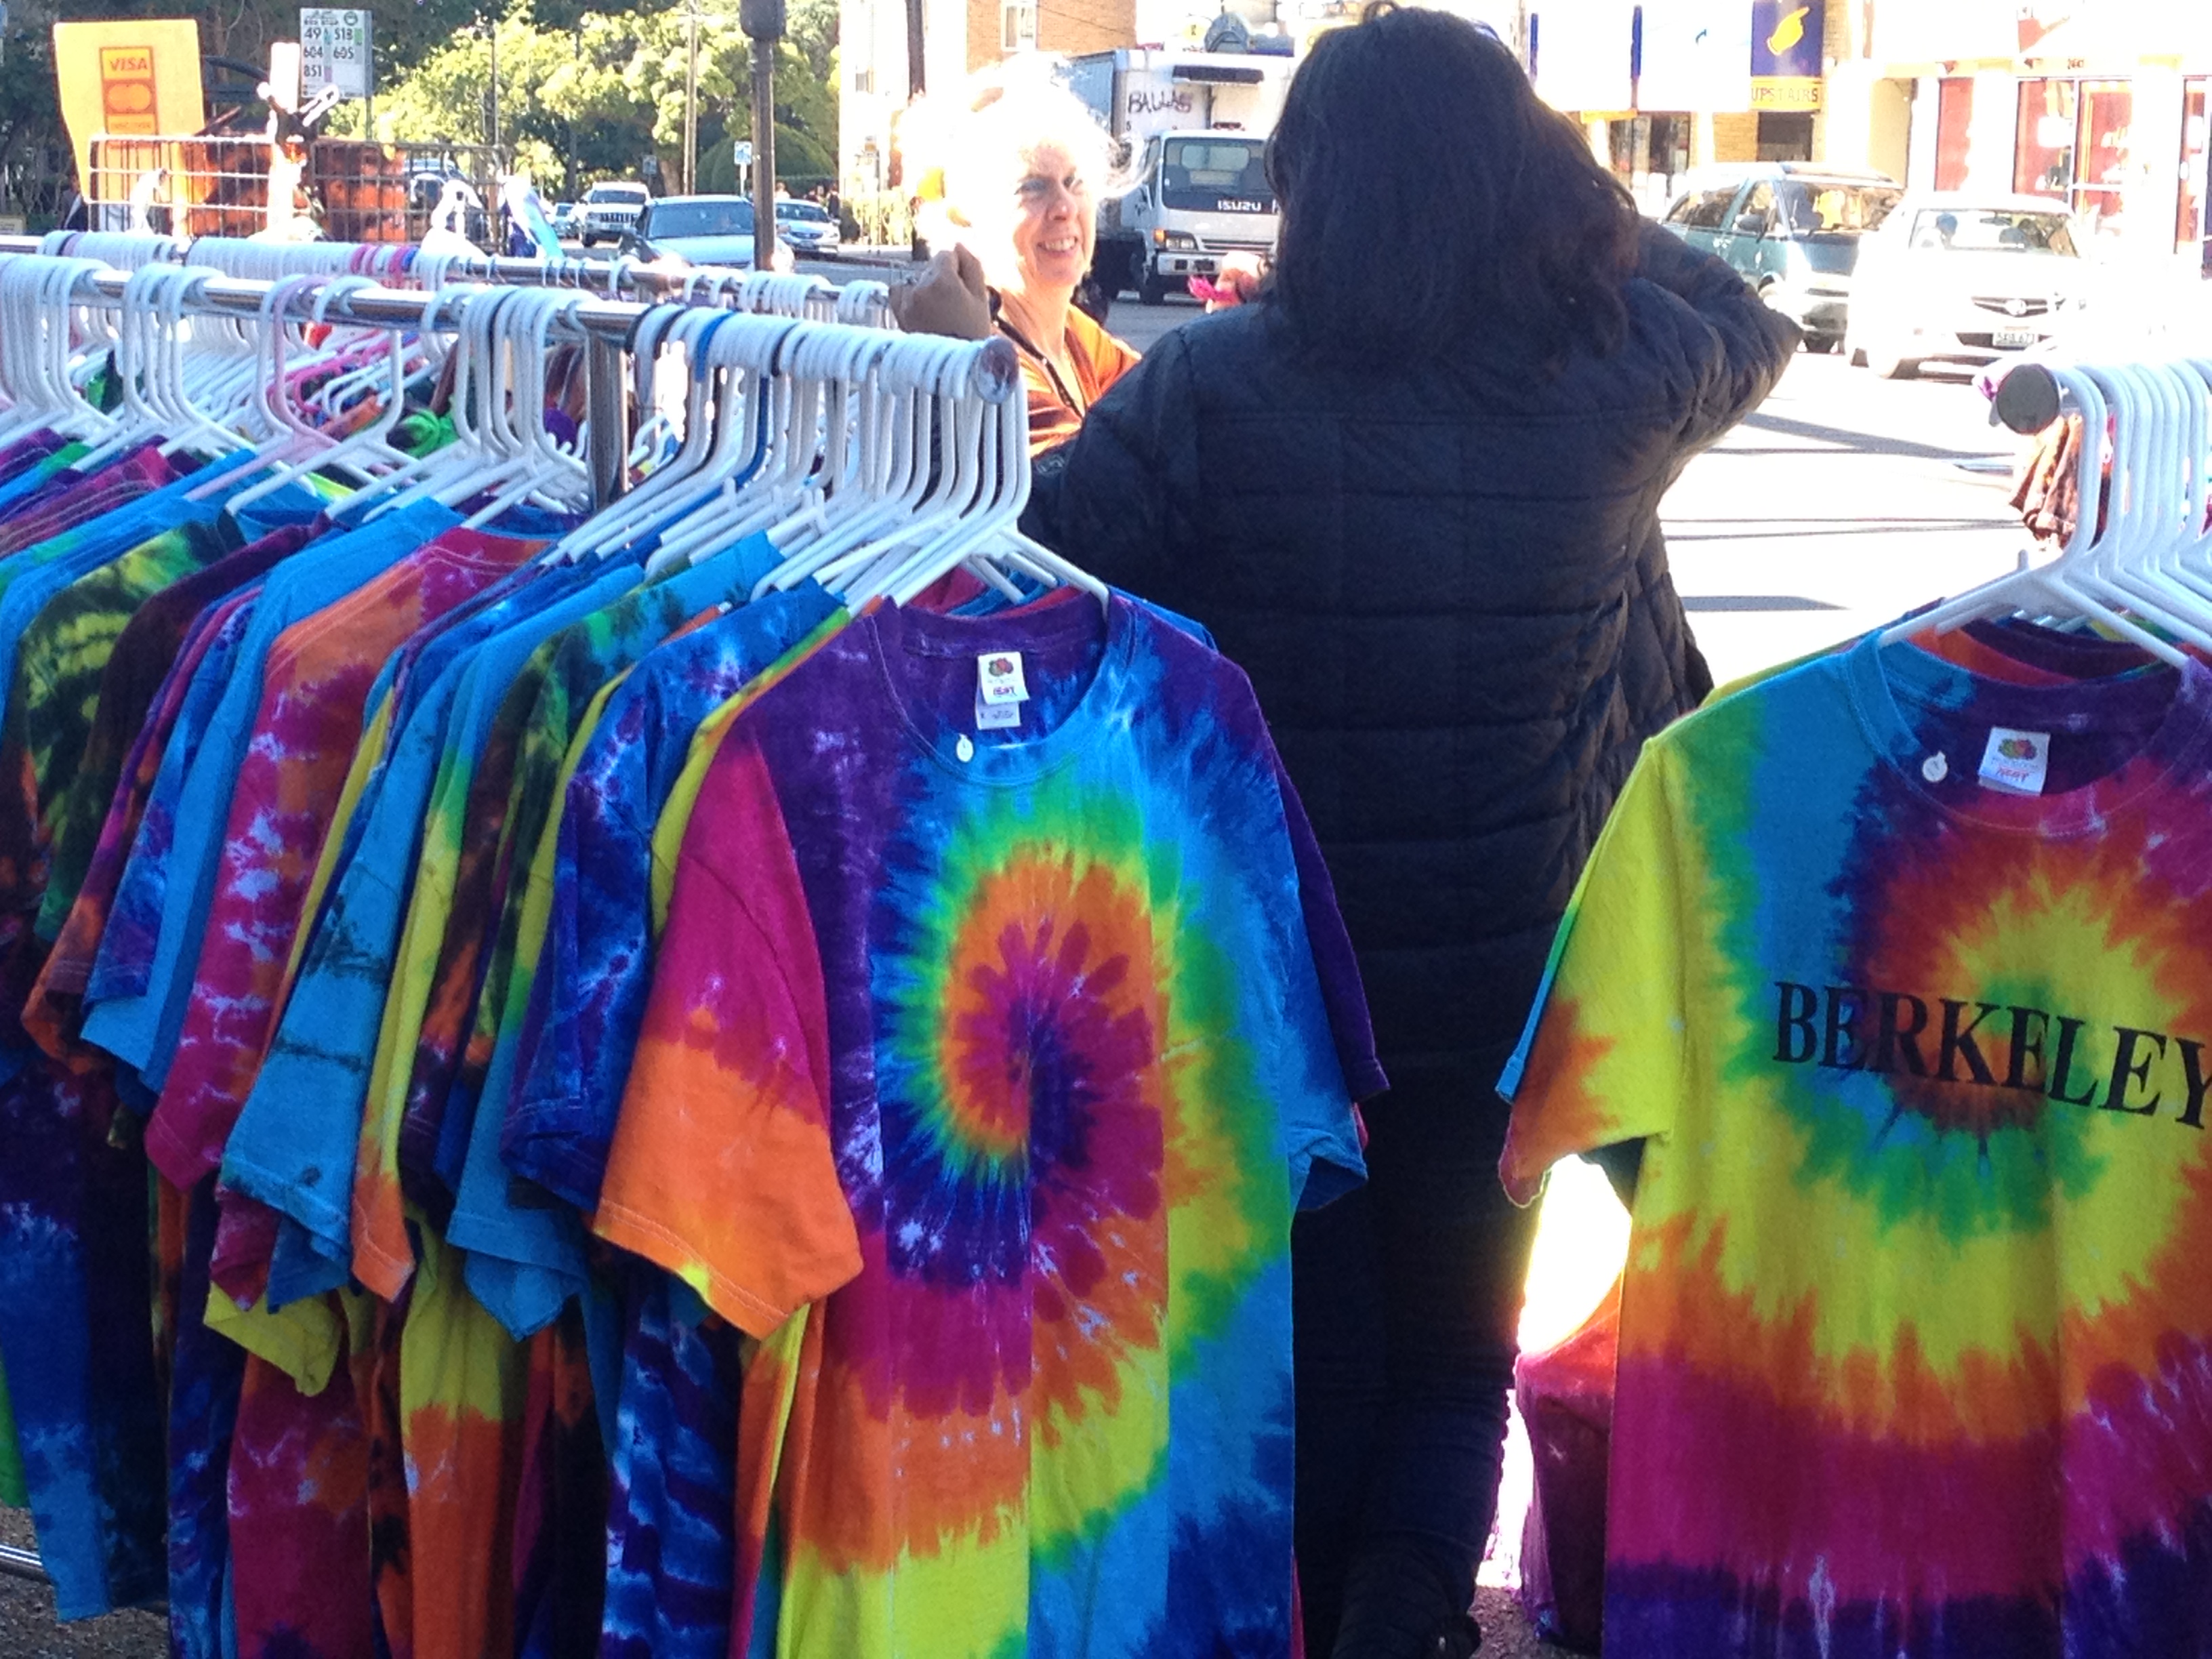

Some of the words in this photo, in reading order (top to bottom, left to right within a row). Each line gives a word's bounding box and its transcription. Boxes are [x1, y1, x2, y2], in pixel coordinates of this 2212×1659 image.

[305, 28, 322, 39] 49
[109, 57, 148, 70] VISA
[304, 65, 322, 77] 851
[1750, 87, 1818, 102] UPSTAIRS
[1217, 199, 1262, 211] ISUZU
[1771, 981, 2212, 1130] BERKELEY
